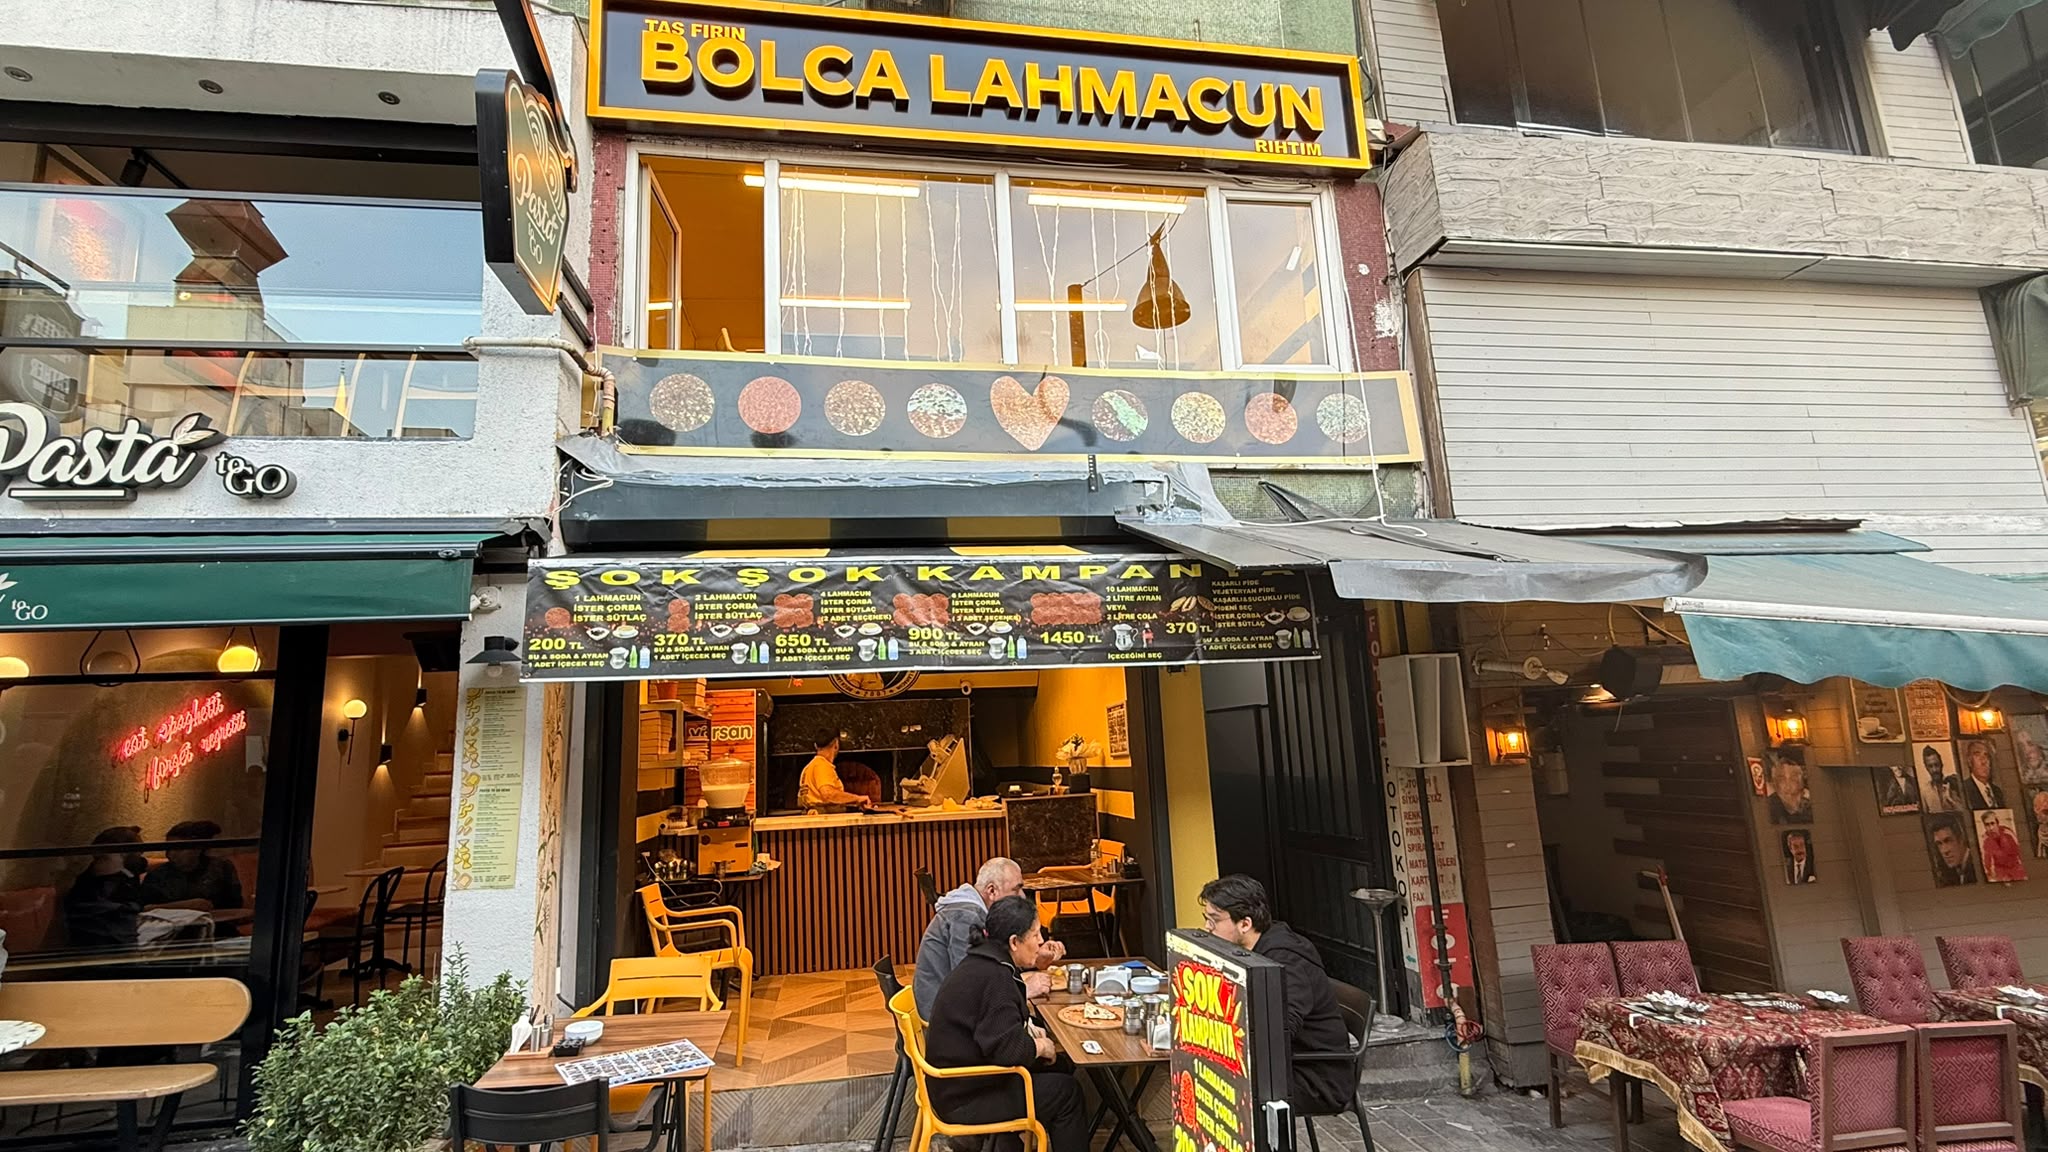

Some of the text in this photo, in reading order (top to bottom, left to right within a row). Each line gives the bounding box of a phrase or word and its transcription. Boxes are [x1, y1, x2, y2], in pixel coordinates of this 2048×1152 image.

[645, 19, 746, 41] TAS FIRIN
[641, 30, 1324, 131] BOLCA LAHMACUN
[1254, 139, 1322, 156] RIHTIM
[514, 153, 558, 246] Pasta
[0, 402, 196, 484] Pasta
[225, 465, 288, 494] GO
[544, 570, 701, 590] ŞOK
[735, 566, 884, 588] ŞOK
[584, 594, 641, 602] LAHMACUN
[846, 598, 872, 606] ÇORBA
[15, 605, 48, 620] GO
[607, 604, 642, 612] ÇORBA
[695, 602, 758, 611] İSTER ÇORBA
[846, 606, 876, 614] SÜTLAÇ
[975, 607, 1004, 615] SÜTLAÇ
[573, 613, 647, 622] İSTER SÜTLAÇ
[695, 611, 763, 620] İSTER SÜTLAÇ
[908, 628, 944, 640] 900
[1166, 622, 1197, 634] 370
[528, 638, 584, 650] 200 TL
[654, 634, 706, 646] 370 TL
[776, 634, 811, 646] 650
[1040, 632, 1084, 644] 1450
[682, 652, 710, 660] İÇECEK
[1108, 652, 1146, 660] İÇECEĞİNİ
[558, 660, 587, 668] İÇECEK
[124, 692, 224, 757] eat spaghetti
[149, 742, 193, 790] forget
[1413, 893, 1425, 901] FAX
[1183, 966, 1224, 1017] ŞOK
[1180, 1006, 1237, 1060] KAMPANYA
[1199, 1061, 1236, 1105] LAHMACUN
[1195, 1078, 1238, 1133] İSTER ÇORBA
[1196, 1102, 1215, 1136] İSTER
